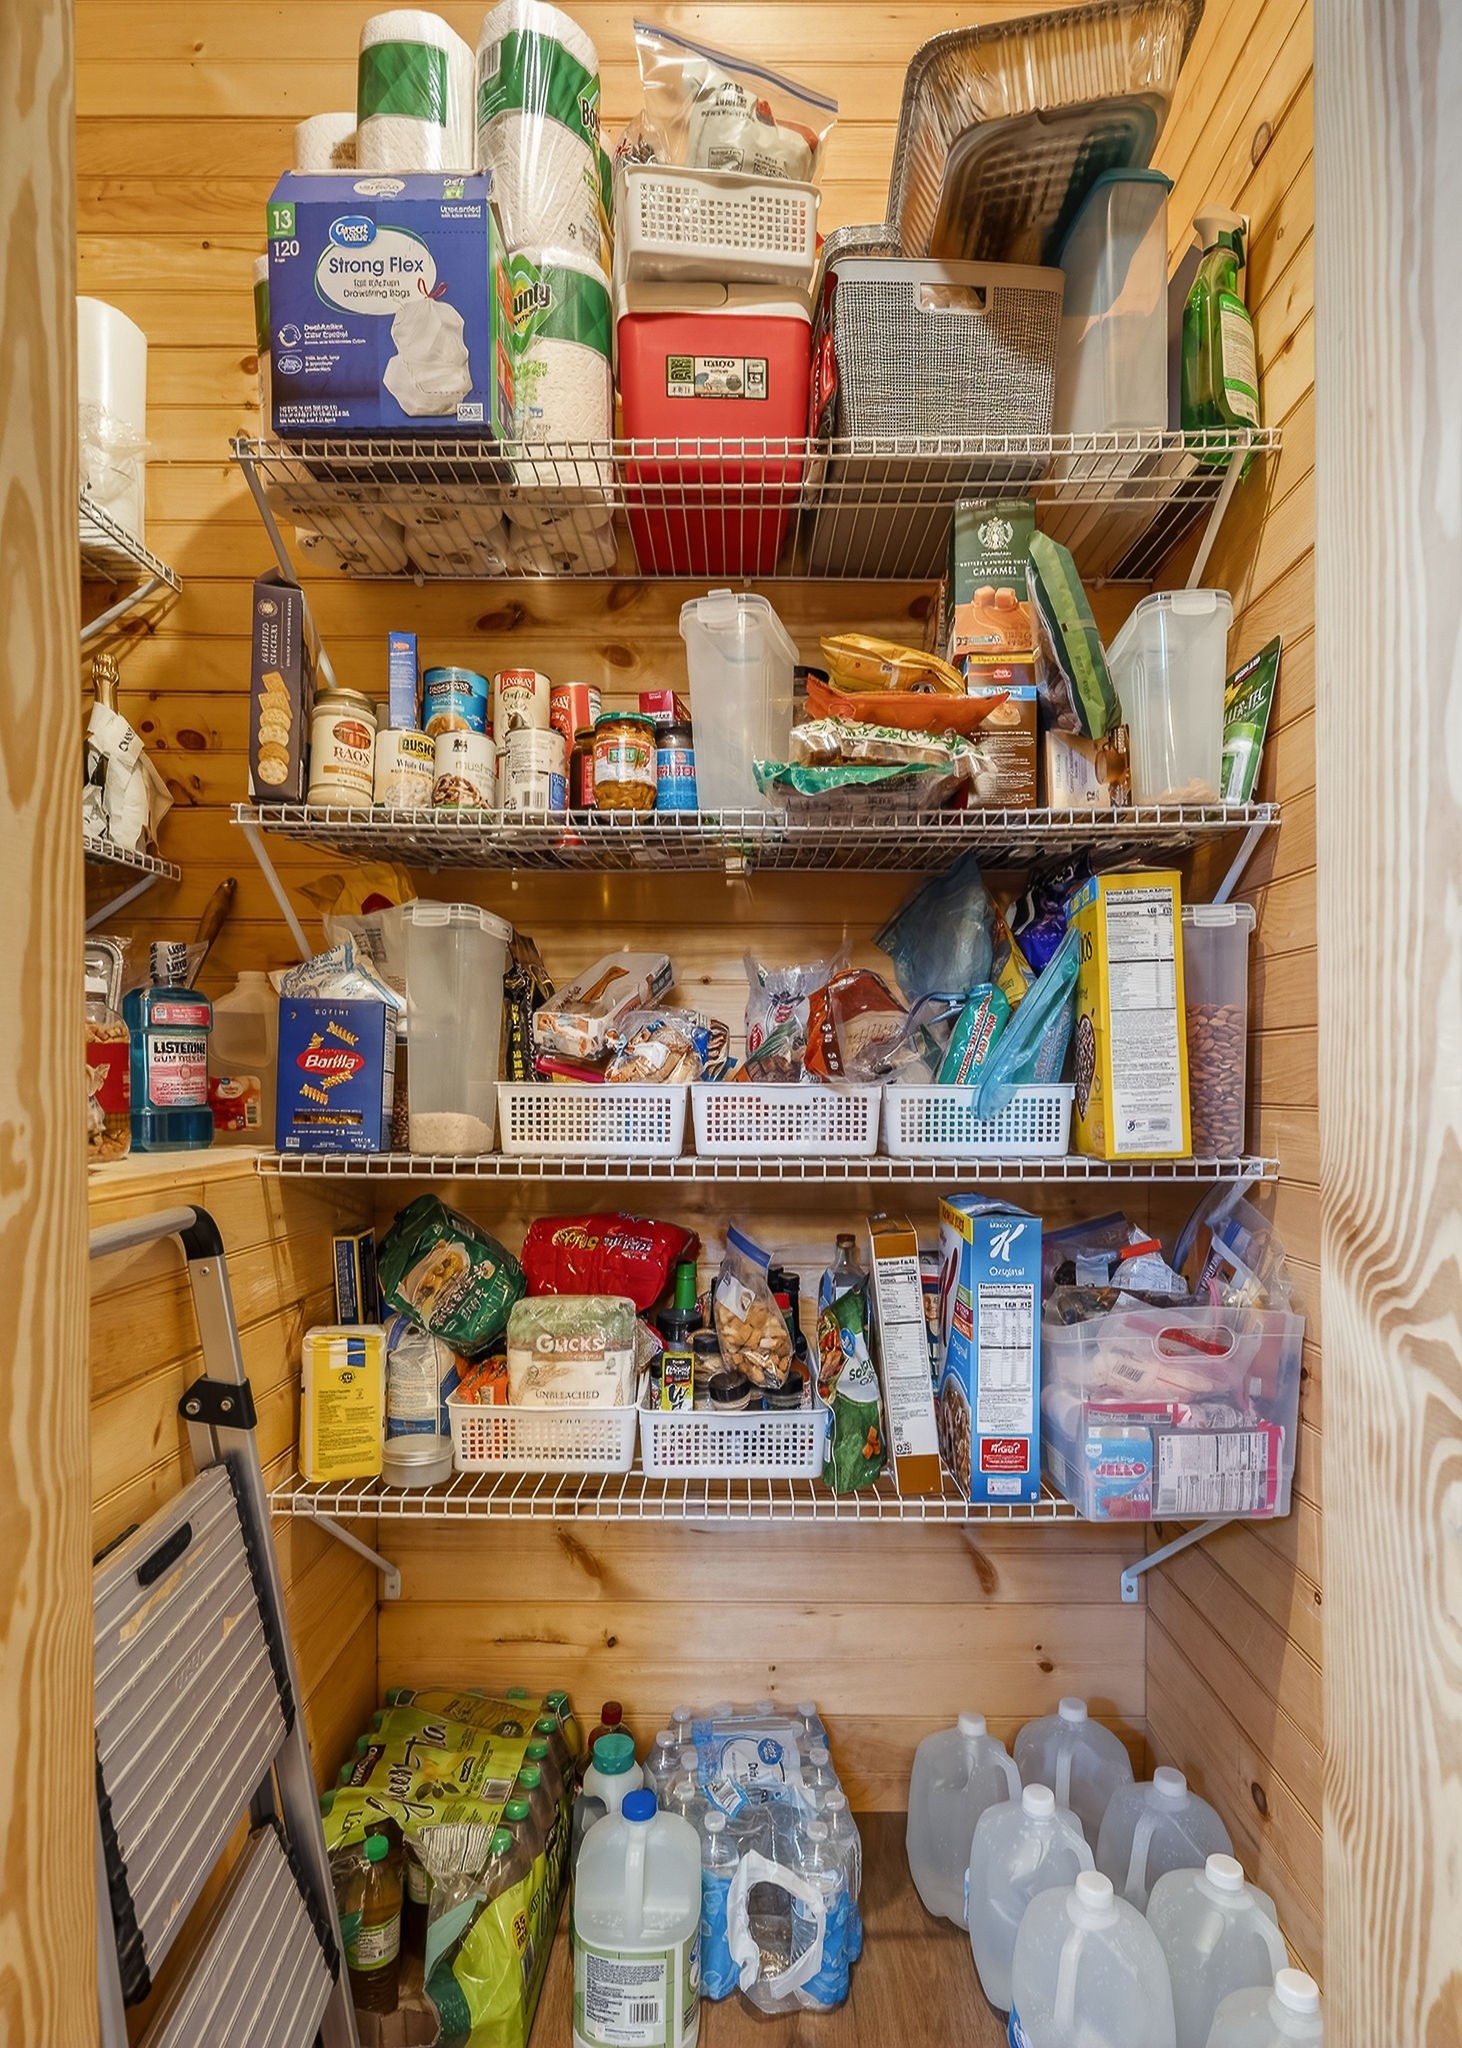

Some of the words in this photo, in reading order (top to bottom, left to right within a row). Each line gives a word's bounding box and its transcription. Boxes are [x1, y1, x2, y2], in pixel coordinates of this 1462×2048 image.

[273, 209, 292, 228] 13
[274, 241, 300, 257] 120
[329, 257, 385, 276] Strong
[390, 257, 424, 273] Flex
[513, 282, 551, 316] unty
[973, 566, 1017, 577] CARAMEL
[305, 1054, 356, 1069] Barilla
[990, 1223, 1025, 1262] K
[989, 1267, 1024, 1277] Original
[536, 1390, 600, 1400] UNBLEACHED
